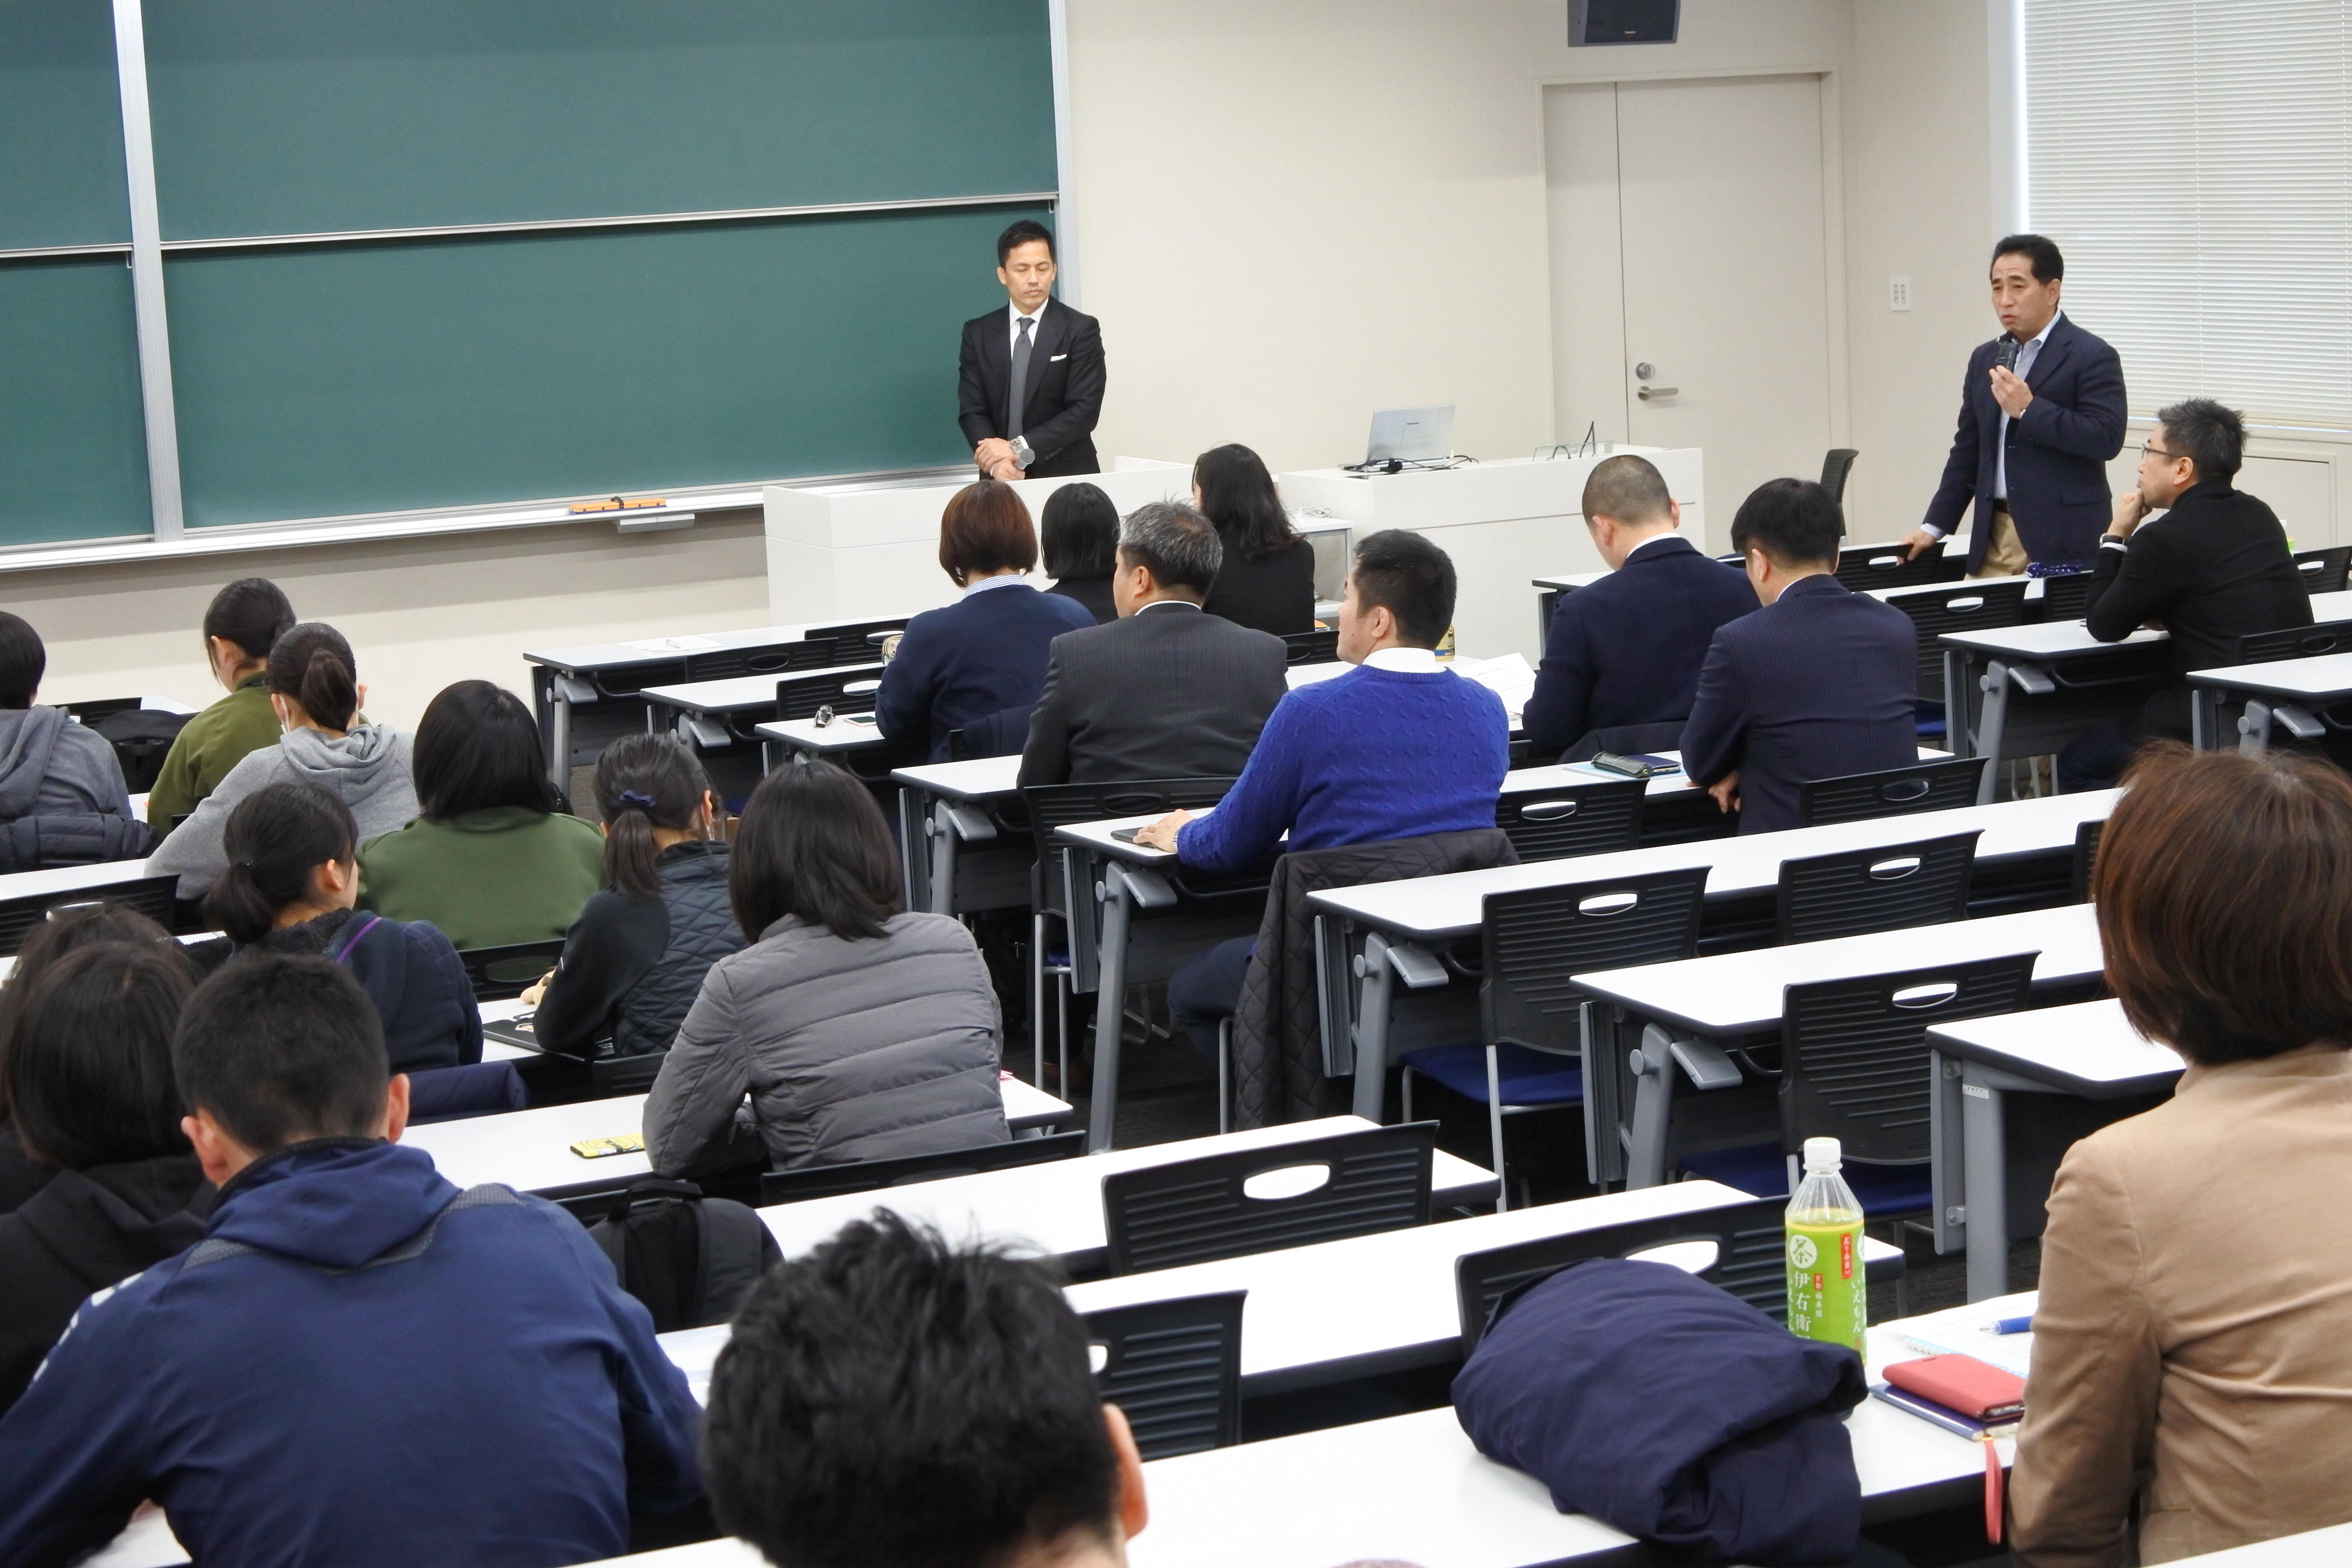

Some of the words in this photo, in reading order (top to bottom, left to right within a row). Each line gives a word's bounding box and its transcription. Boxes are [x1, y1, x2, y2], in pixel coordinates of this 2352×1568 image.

[1793, 1239, 1812, 1264] 茶
[1794, 1271, 1811, 1339] 伊右衛
[1851, 1279, 1861, 1333] いえもん
